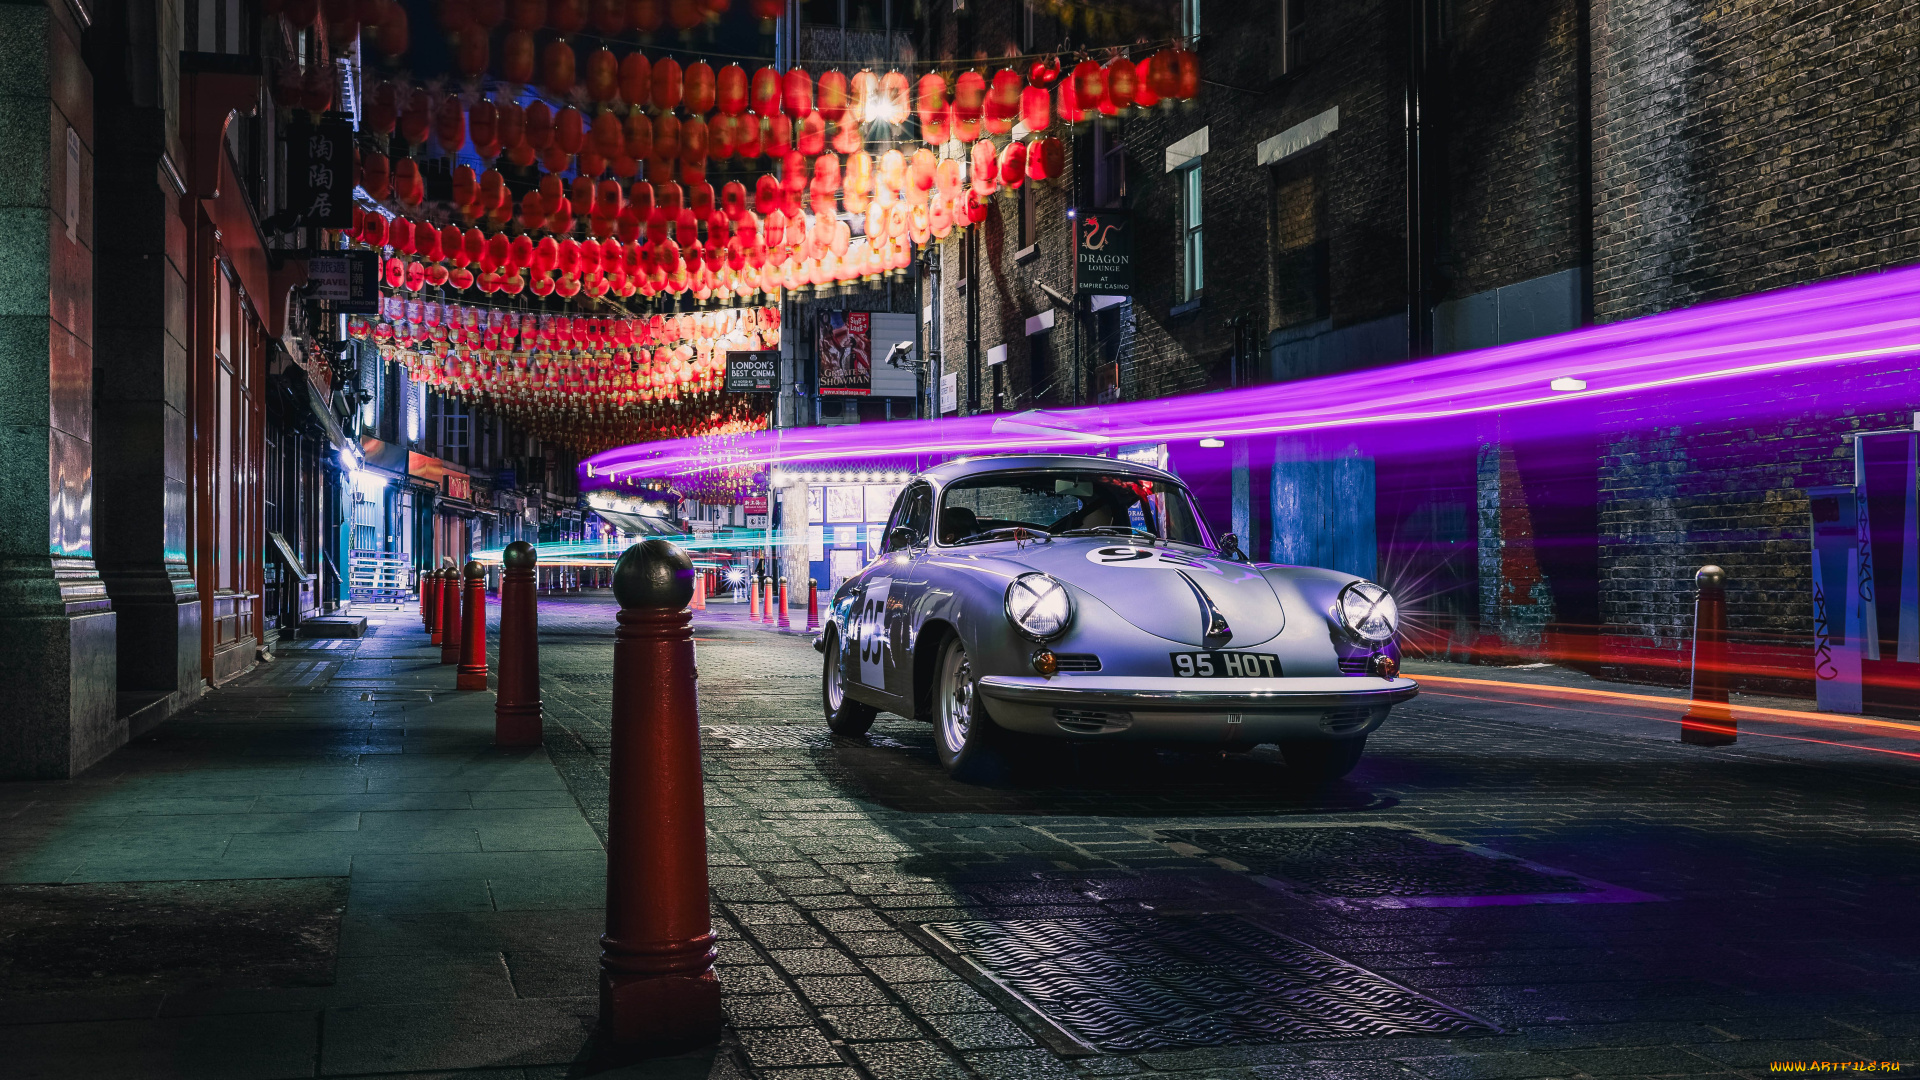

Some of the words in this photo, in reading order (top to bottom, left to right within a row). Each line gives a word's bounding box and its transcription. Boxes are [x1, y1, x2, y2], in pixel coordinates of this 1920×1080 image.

[308, 135, 334, 218] 陶陶居
[1079, 254, 1129, 264] DRAGON
[1088, 264, 1120, 272] LOUNGE
[731, 361, 774, 370] LONDON'S
[820, 376, 870, 386] SHOWMAN
[1175, 654, 1215, 677] 95
[1223, 653, 1275, 678] HOT
[1228, 713, 1242, 723] TOW
